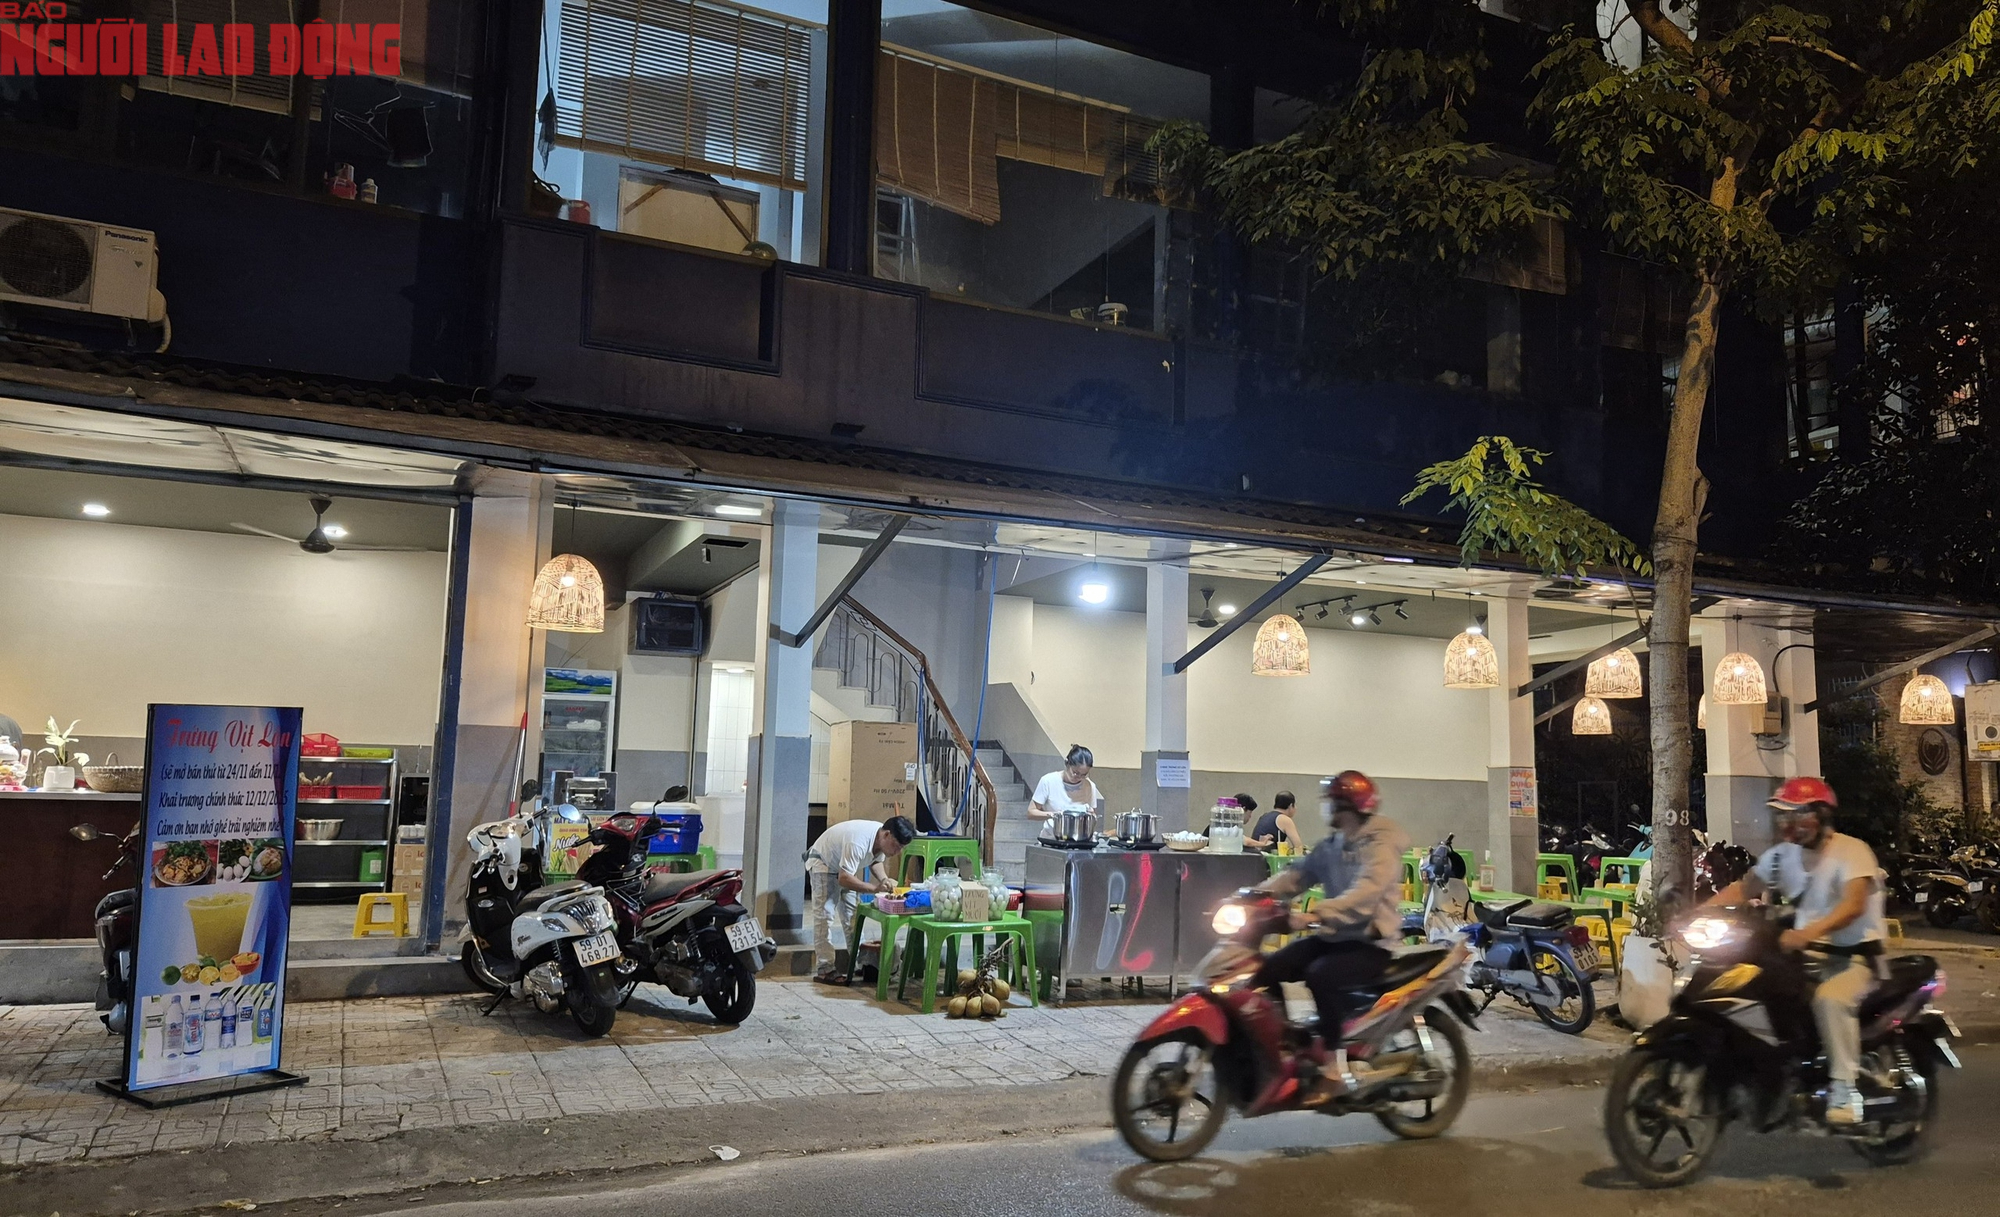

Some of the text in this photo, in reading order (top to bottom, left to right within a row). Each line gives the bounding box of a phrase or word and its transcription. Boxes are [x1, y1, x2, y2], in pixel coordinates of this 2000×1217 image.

[105, 230, 148, 243] Panasonic
[167, 718, 219, 754] Trứng
[224, 719, 254, 754] Vịt
[187, 763, 202, 779] bán
[226, 763, 248, 780] 24/11
[249, 762, 262, 779] đến
[159, 791, 178, 808] Khai
[205, 791, 227, 807] chính
[228, 791, 244, 807] thức
[1665, 808, 1690, 826] 98
[157, 819, 174, 837] Cảm
[185, 820, 199, 838] bạn
[214, 818, 227, 838] ghé
[228, 816, 241, 835] trải
[242, 818, 267, 837] nghiệm
[730, 921, 755, 937] 59-E1
[579, 934, 608, 952] 59-D1
[732, 932, 763, 951] 231.54
[581, 944, 615, 964] 468.27
